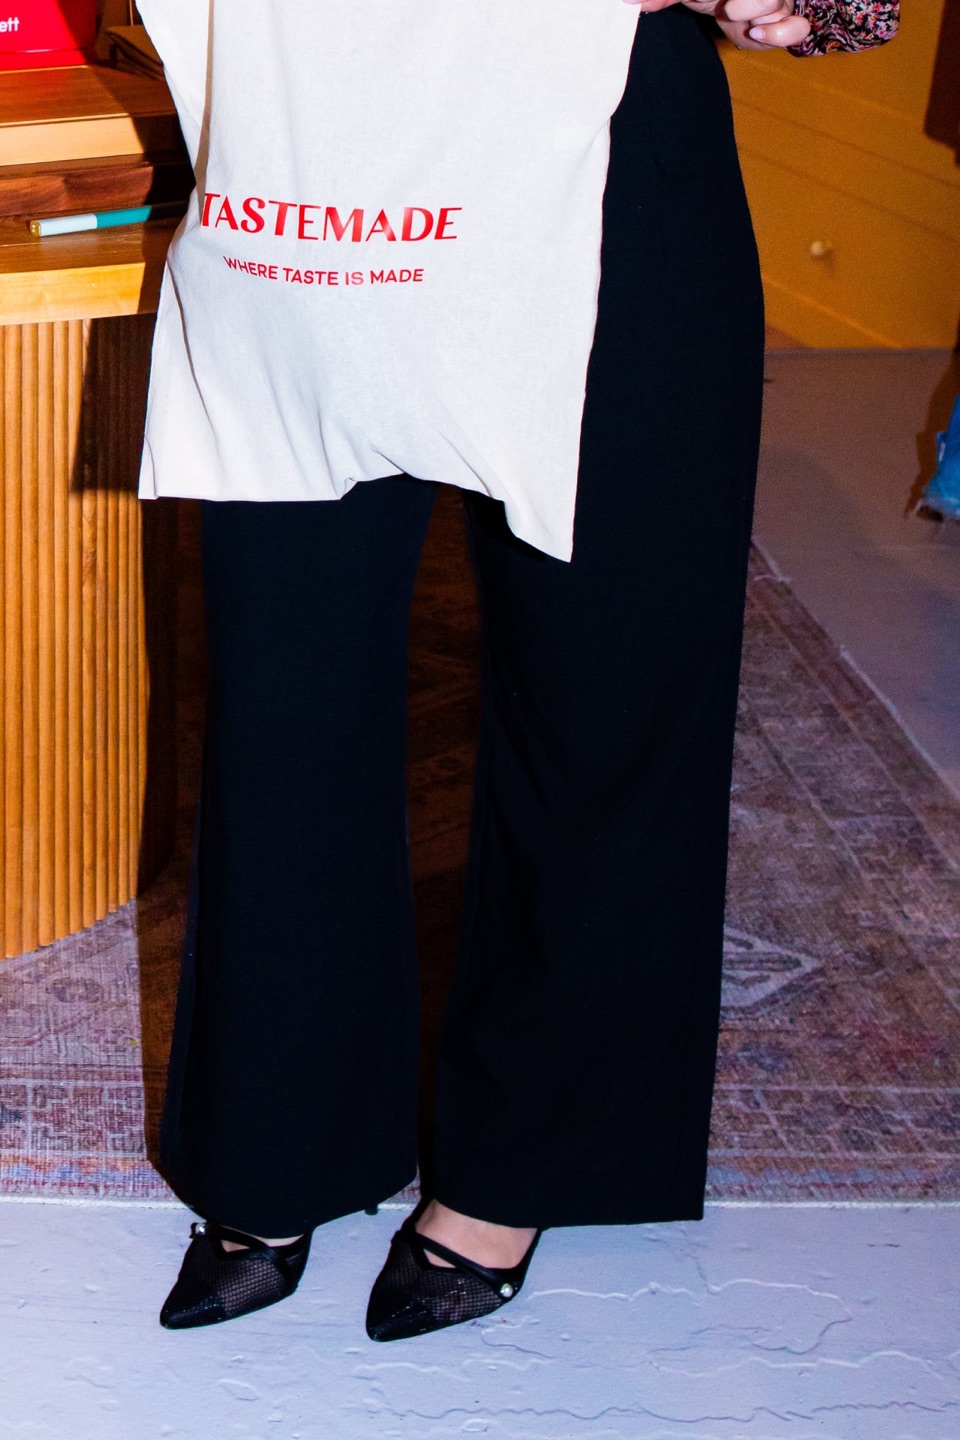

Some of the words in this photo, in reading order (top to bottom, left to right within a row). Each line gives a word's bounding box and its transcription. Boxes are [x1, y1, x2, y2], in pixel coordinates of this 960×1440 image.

[201, 192, 463, 243] TASTEMADE
[222, 256, 278, 280] WHERE
[282, 267, 338, 286] TASTE
[345, 272, 364, 285] IS
[370, 268, 424, 283] MADE
